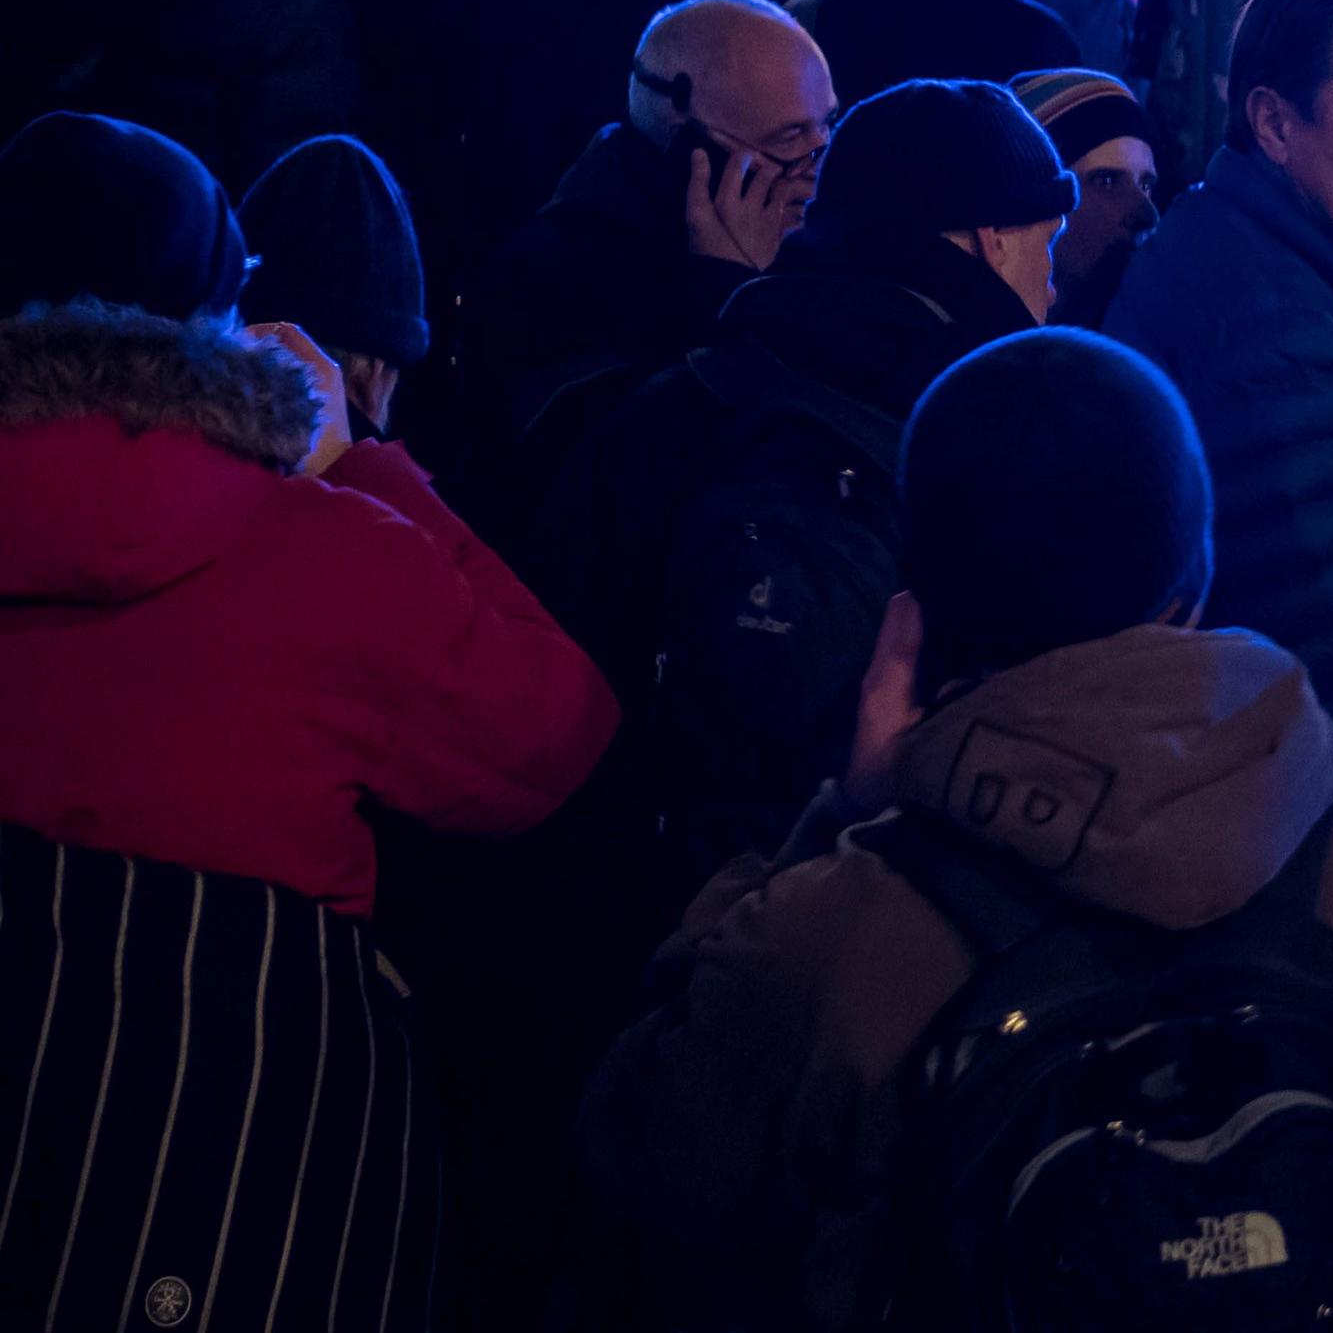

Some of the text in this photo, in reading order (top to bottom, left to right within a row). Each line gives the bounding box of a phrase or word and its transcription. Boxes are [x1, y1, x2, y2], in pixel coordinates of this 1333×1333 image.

[1195, 1212, 1246, 1239] THE
[1159, 1231, 1247, 1262] NORTH
[1186, 1253, 1248, 1280] FACE
